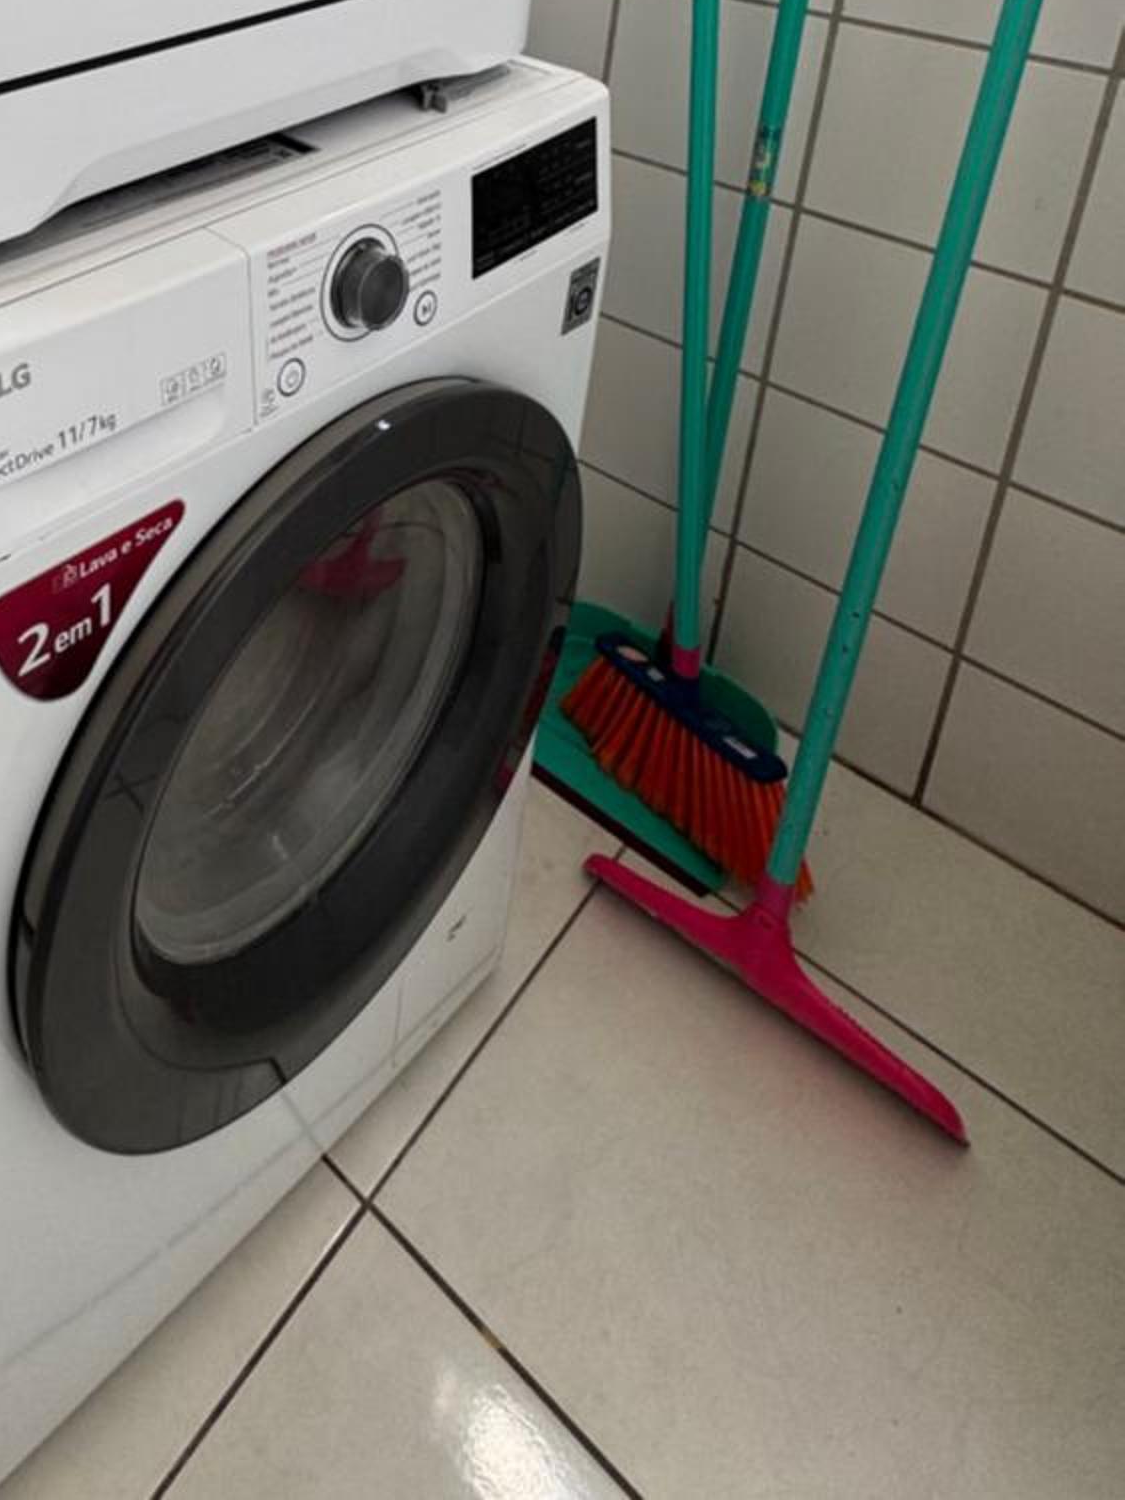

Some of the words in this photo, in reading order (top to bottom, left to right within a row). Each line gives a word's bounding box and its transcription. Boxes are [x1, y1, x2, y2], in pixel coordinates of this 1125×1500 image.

[78, 546, 119, 579] Lava
[120, 539, 133, 555] e
[135, 516, 173, 548] Seca
[16, 621, 52, 678] 2
[53, 616, 93, 654] em
[90, 581, 112, 628] 1
